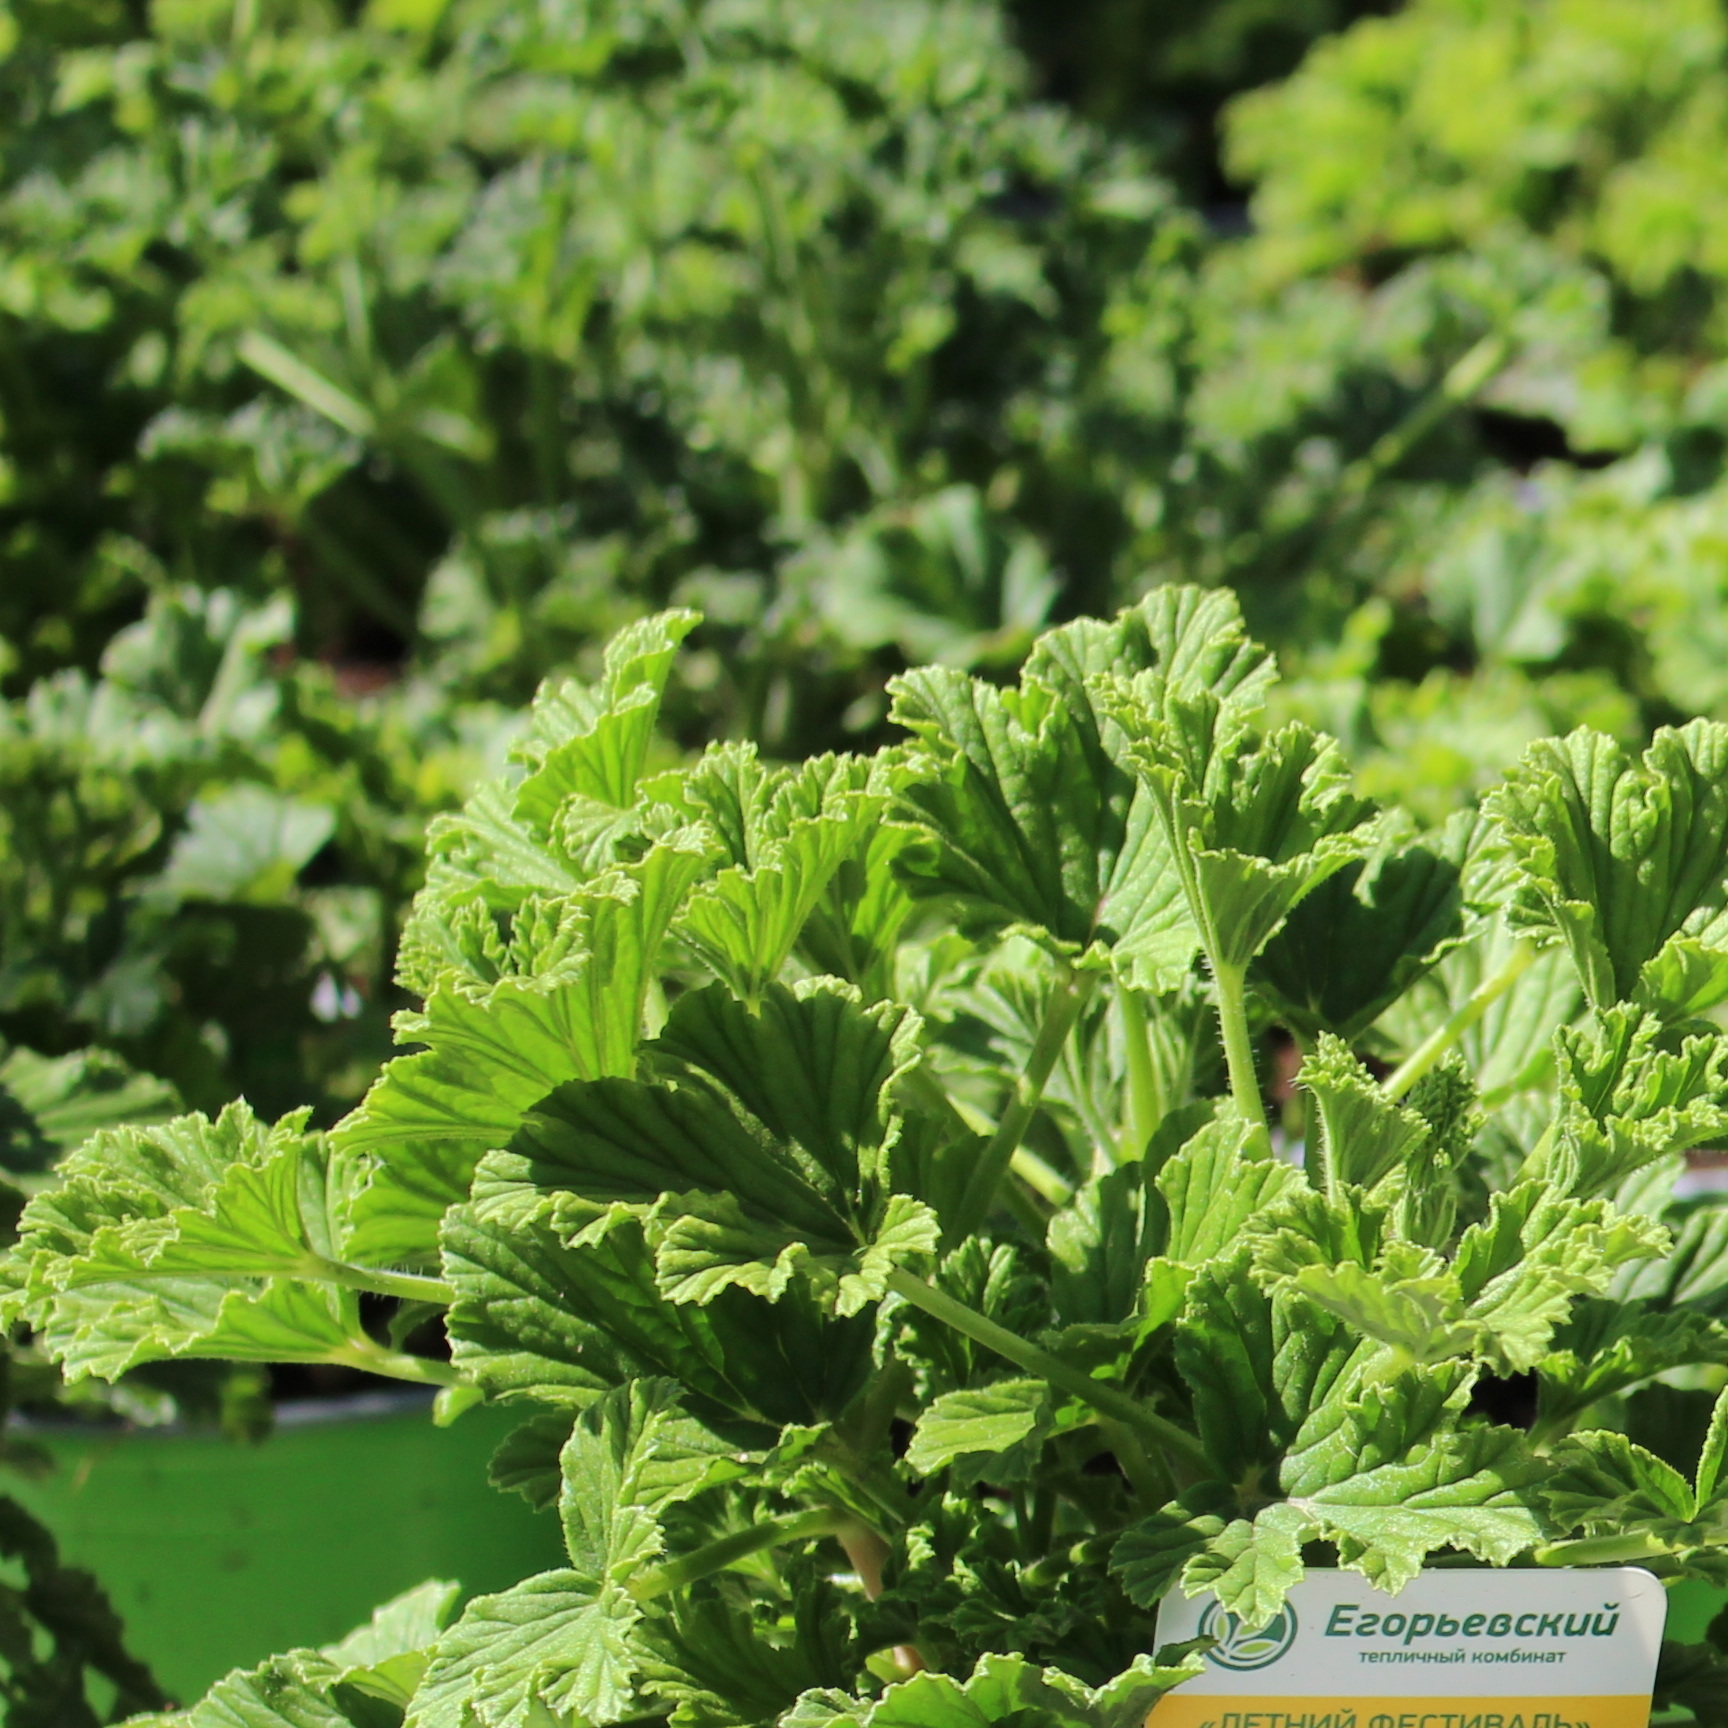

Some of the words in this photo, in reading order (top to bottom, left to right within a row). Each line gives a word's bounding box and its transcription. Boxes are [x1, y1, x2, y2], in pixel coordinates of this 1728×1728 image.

[1324, 1603, 1620, 1646] Егорьевский
[1359, 1649, 1466, 1665] тепличный
[1472, 1649, 1567, 1665] комбинат
